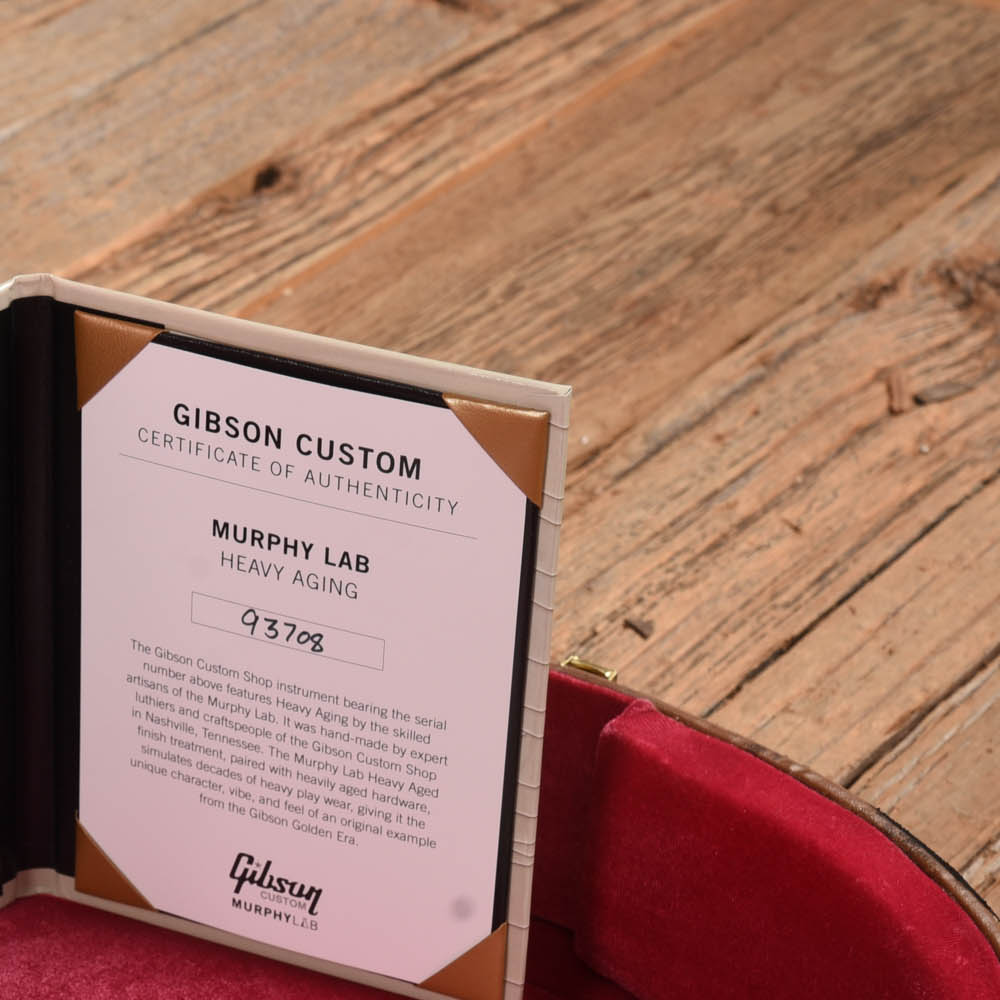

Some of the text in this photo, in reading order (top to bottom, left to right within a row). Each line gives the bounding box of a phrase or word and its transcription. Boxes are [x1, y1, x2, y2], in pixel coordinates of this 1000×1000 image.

[137, 427, 460, 515] CERTIFICATE OF AUTHENTICITY
[173, 403, 422, 480] GIBSON CUSTOM
[212, 519, 371, 574] MURPHY LAB
[220, 552, 358, 600] HEAVY AGING
[241, 608, 325, 653] 93708
[126, 673, 448, 767] artisans of the Murphy Lab. It was hand-made by expert
[132, 639, 447, 731] The Gibson Custom Shop instrument bearing the serial
[143, 662, 431, 745] number above features Heavy Aging by the skilled
[131, 706, 439, 799] in Nashville, Tennessee. The Murphy Lab Heavy Aged
[135, 691, 437, 782] luthiers and craftspeople of the Gibson Custom Shop
[137, 724, 430, 816] finish treatment, paired with heavily aged hardware,
[130, 758, 437, 849] unique character, vibe, and feel of an original example
[141, 744, 426, 830] simulates decades of heavy play wear, giving it the
[199, 792, 357, 846] from the Gibson Golden Era.
[229, 852, 323, 916] Gibson
[260, 891, 307, 910] CUSTOM
